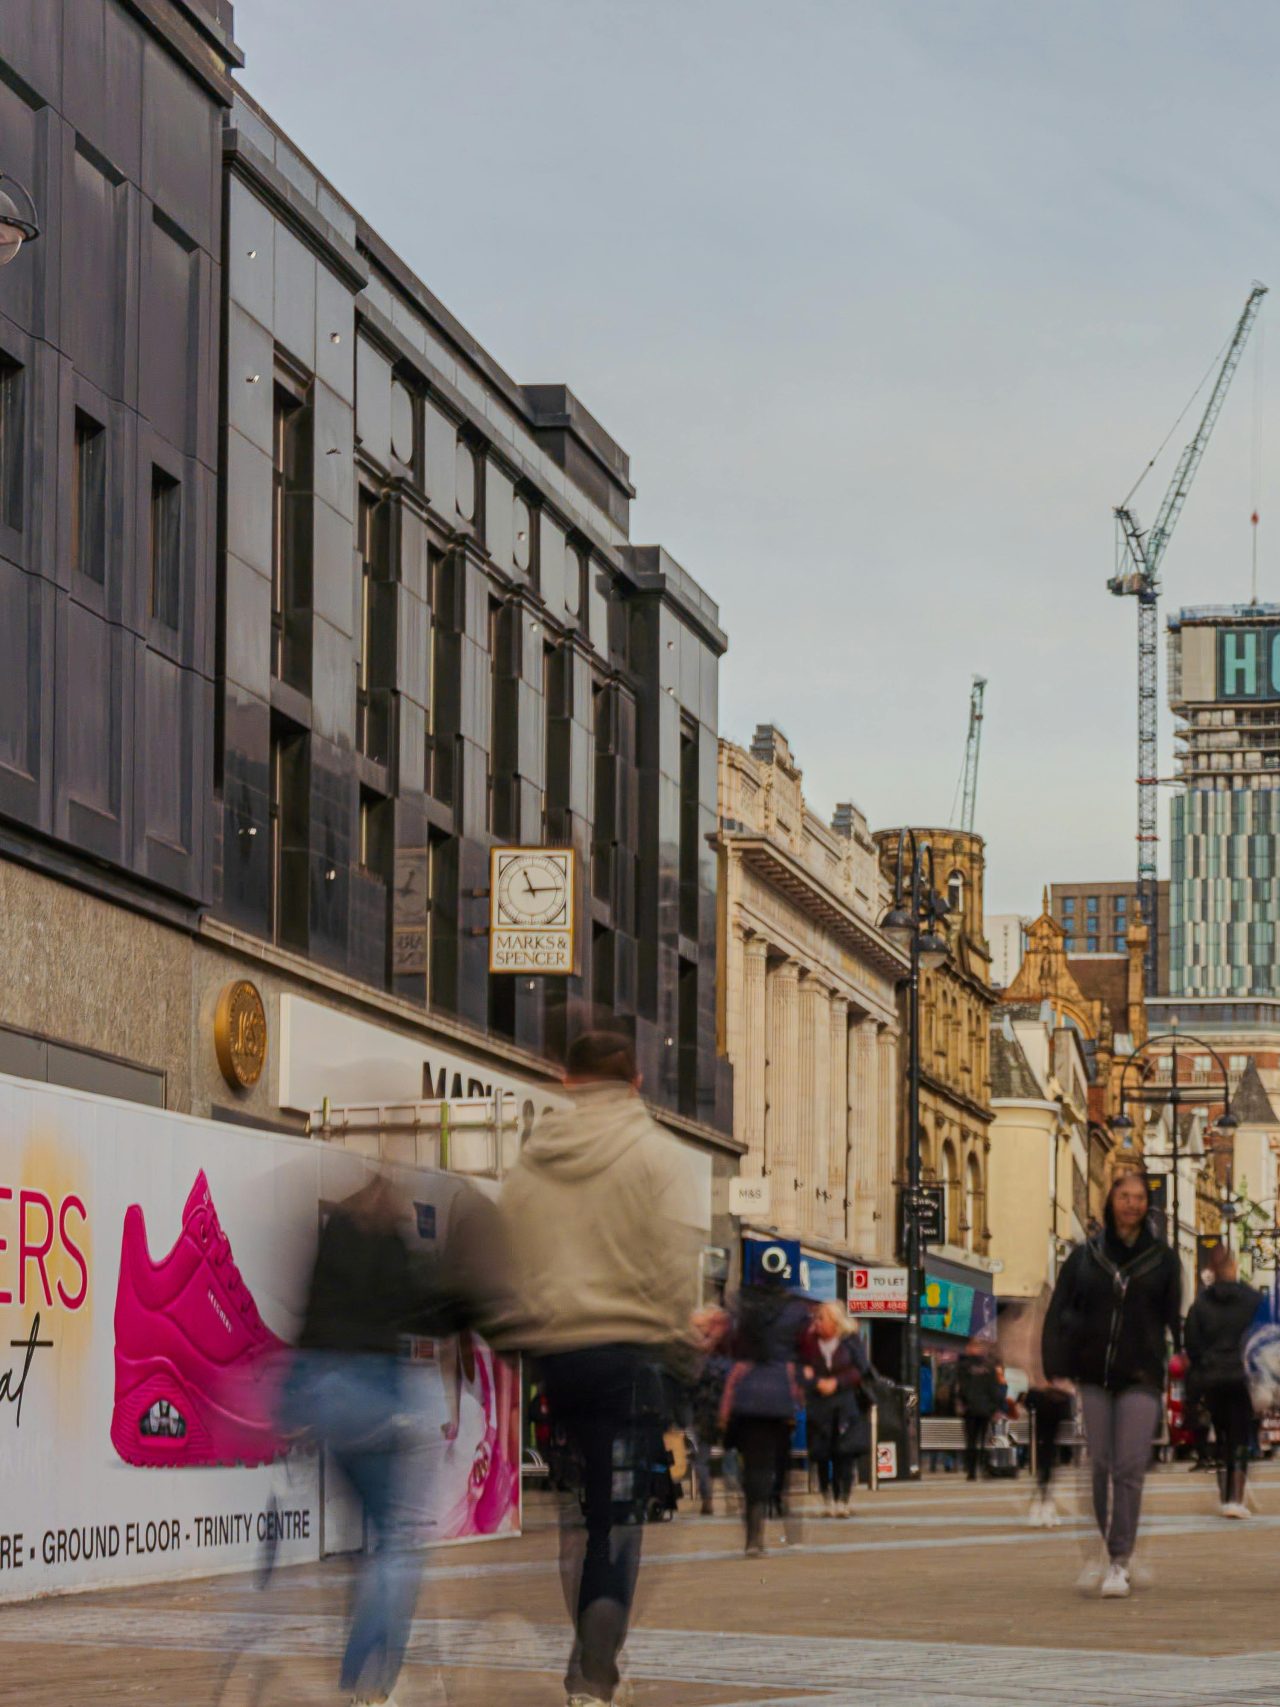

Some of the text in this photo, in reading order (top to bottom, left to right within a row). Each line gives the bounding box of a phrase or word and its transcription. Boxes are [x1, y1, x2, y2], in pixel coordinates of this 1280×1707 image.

[496, 936, 555, 950] MARKS
[496, 952, 567, 966] SPENCER
[738, 1189, 762, 1200] M&S
[873, 1277, 905, 1287] TO LET
[42, 1524, 120, 1564] GROUND
[126, 1519, 181, 1556] FLOOR
[194, 1513, 253, 1547] TRINITY
[256, 1509, 311, 1542] CENTRE
